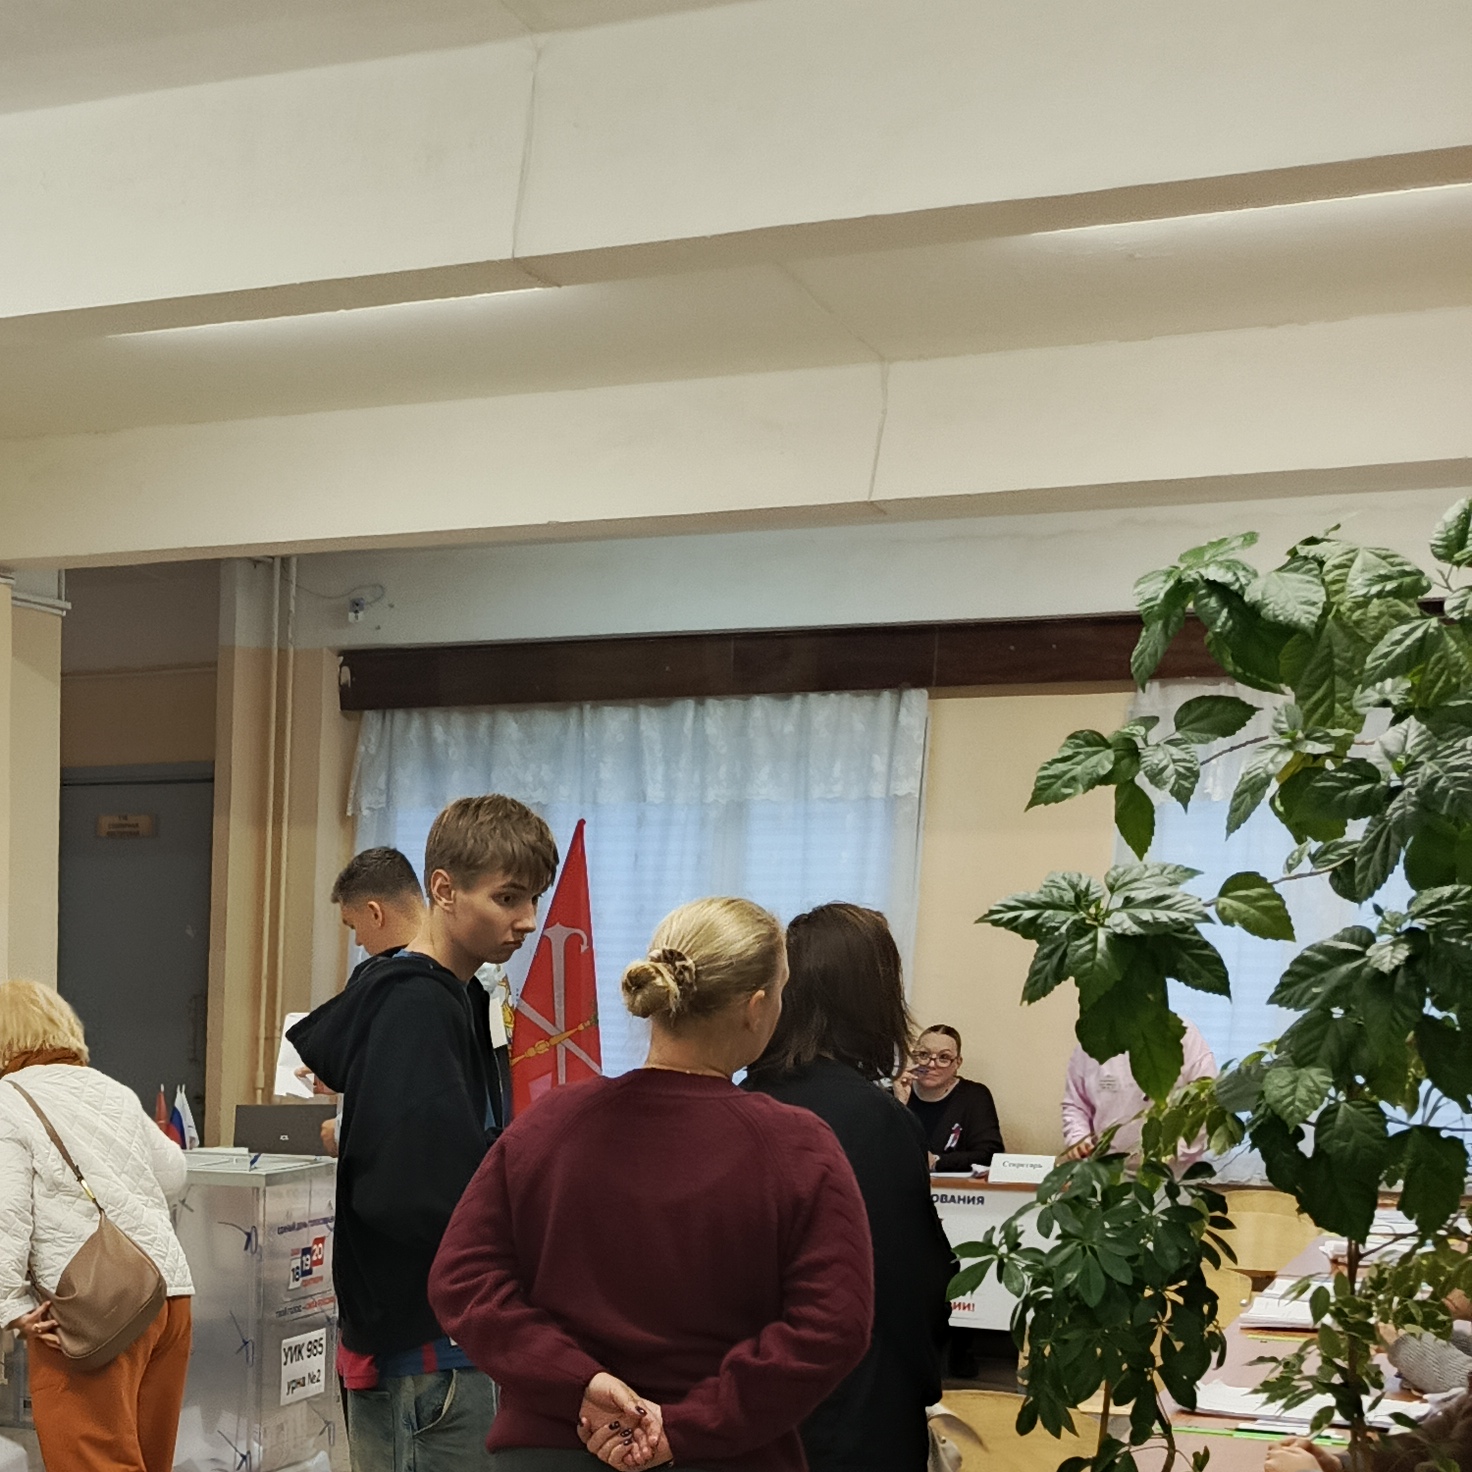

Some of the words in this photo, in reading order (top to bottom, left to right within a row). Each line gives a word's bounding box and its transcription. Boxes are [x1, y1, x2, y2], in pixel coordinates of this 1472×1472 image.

[1002, 1160, 1043, 1169] Секретарь
[930, 1193, 985, 1205] ОВАНИЯ
[312, 1243, 323, 1260] 20
[302, 1254, 311, 1271] 19
[291, 1265, 301, 1282] 18
[952, 1301, 976, 1312] ИИ!
[283, 1342, 305, 1366] УИК
[306, 1337, 324, 1358] 985
[285, 1376, 306, 1396] урна
[308, 1368, 321, 1384] №2
